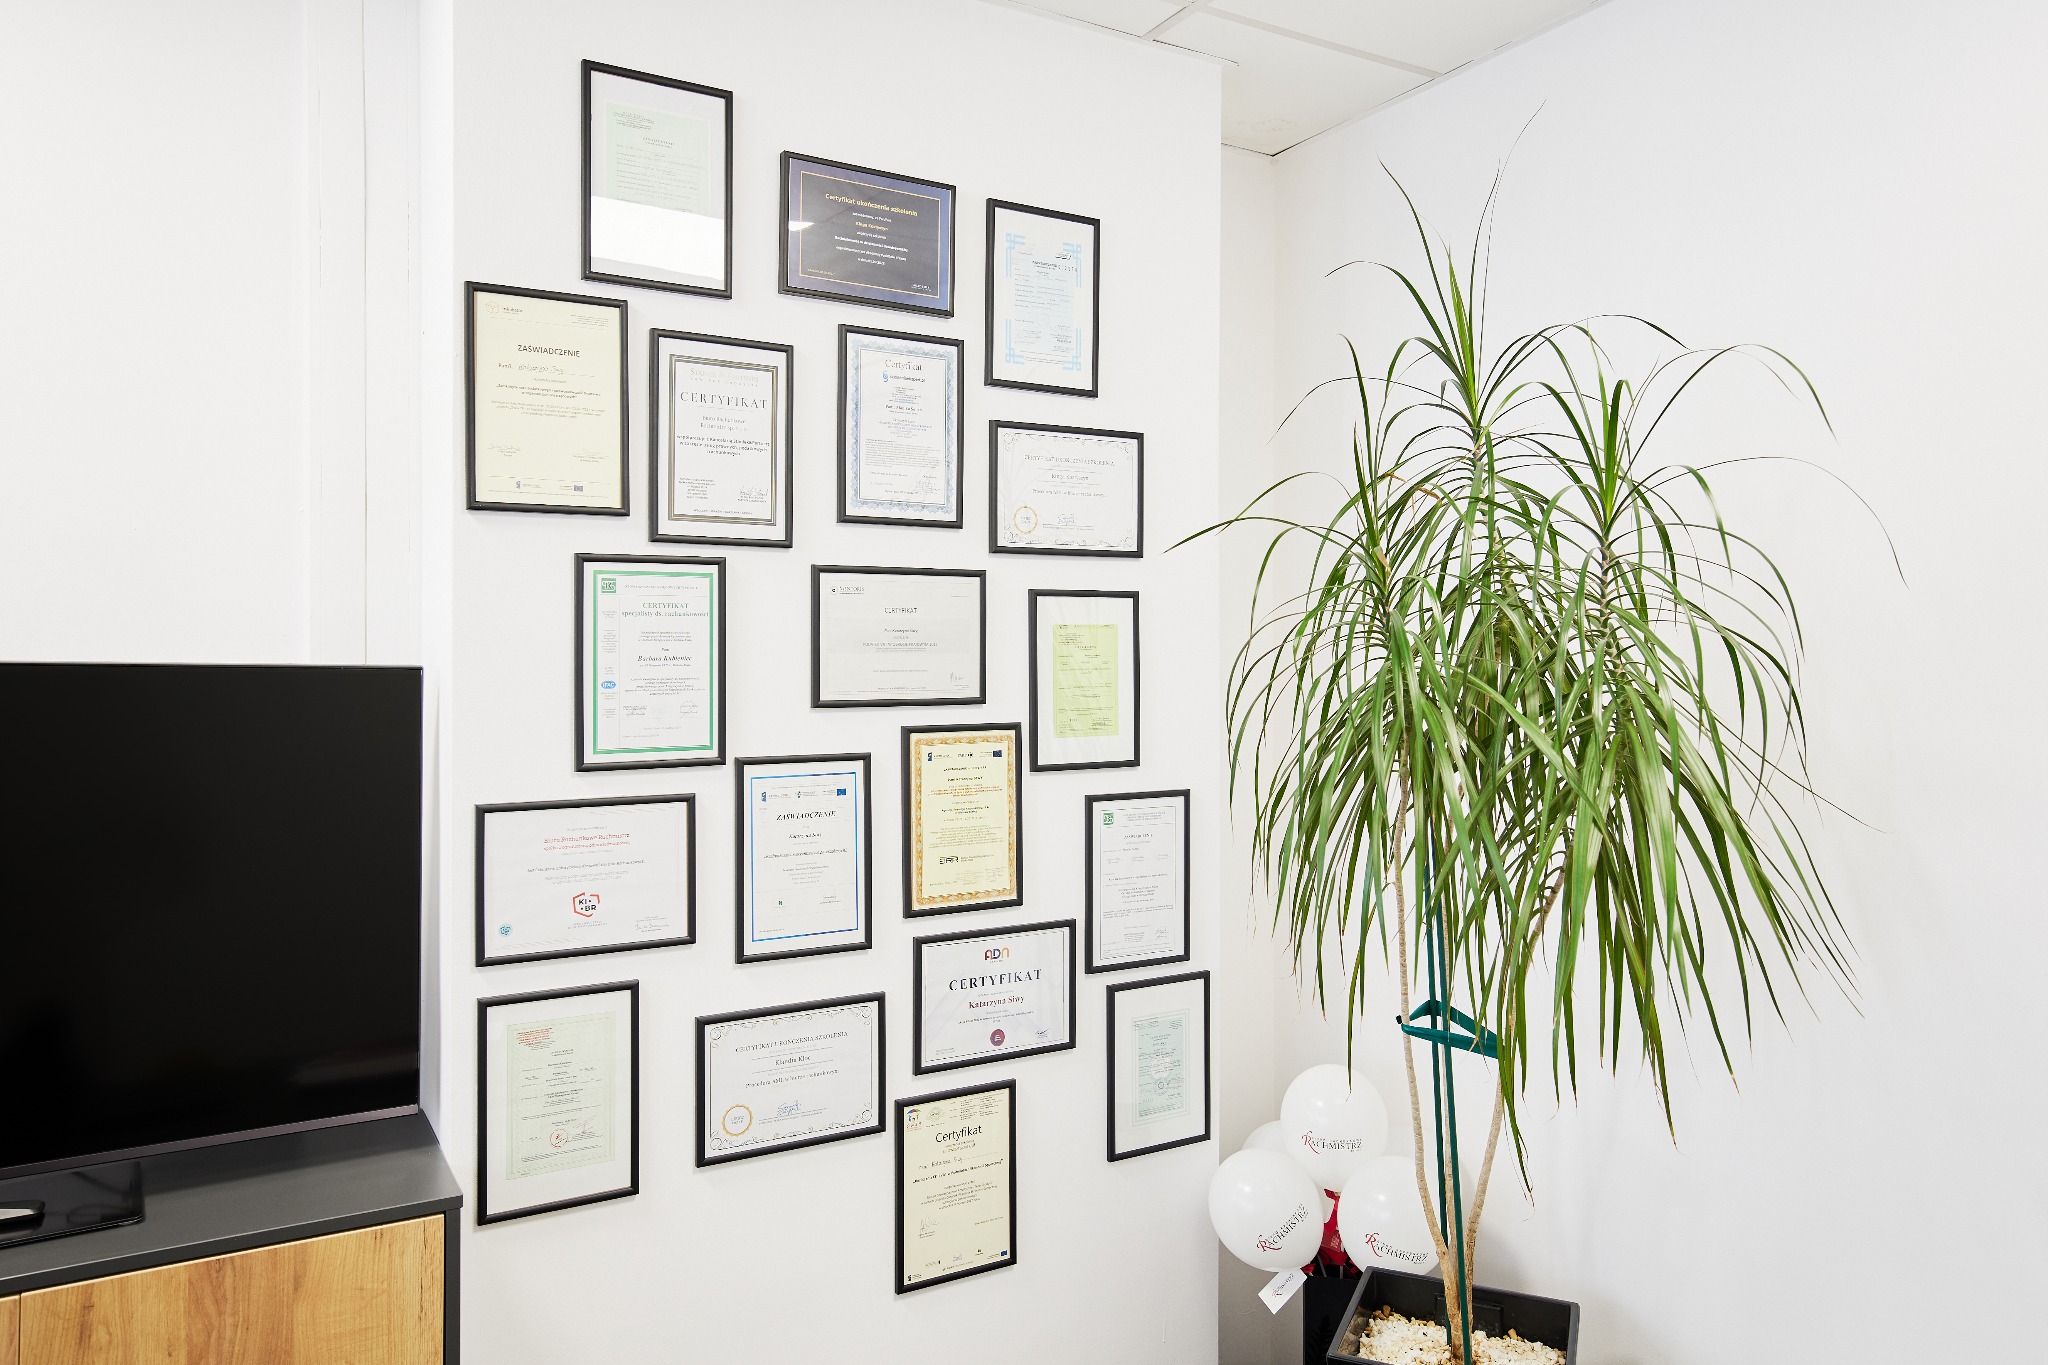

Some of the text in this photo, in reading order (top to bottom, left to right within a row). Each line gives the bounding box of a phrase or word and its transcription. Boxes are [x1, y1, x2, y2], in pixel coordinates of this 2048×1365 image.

[825, 193, 856, 205] Certyfikat
[517, 344, 581, 358] ZAŚWIADCZENIE
[680, 391, 768, 410] CERTYFIKAT
[948, 968, 1042, 992] CERTYFIKAT
[968, 995, 1025, 1009] Katarzyna Siwy
[935, 1125, 983, 1143] Certyfikat
[1301, 1130, 1363, 1155] RACHMISTRZ
[1256, 1205, 1307, 1252] RACHMISTRZ
[1365, 1232, 1428, 1262] RACHMISTRZ
